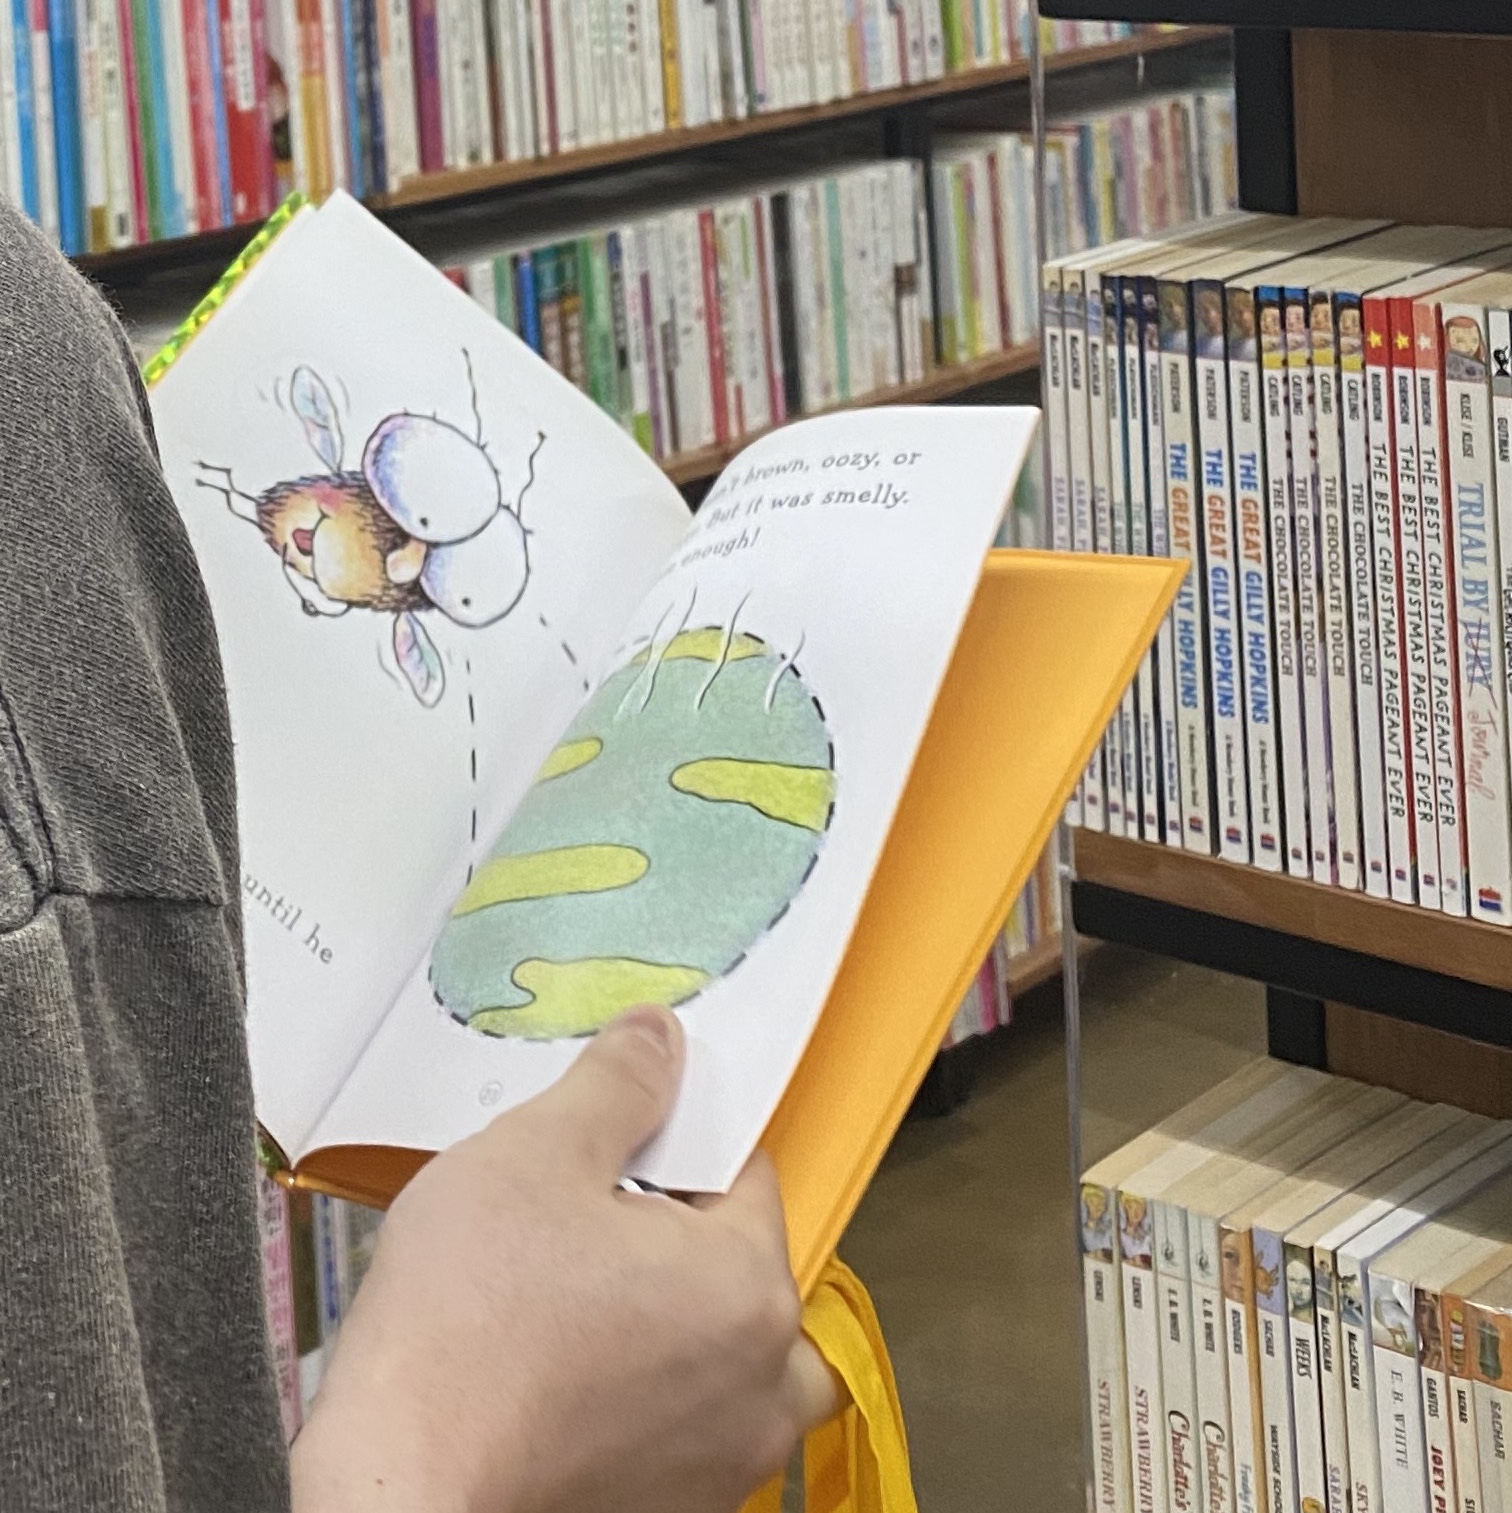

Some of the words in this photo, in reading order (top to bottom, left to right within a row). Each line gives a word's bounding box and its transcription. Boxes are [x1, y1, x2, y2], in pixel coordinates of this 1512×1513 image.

[820, 452, 880, 471] oozy,
[892, 451, 922, 466] or
[1170, 442, 1188, 482] THE
[1373, 443, 1389, 483] THE
[1399, 445, 1416, 485] THE
[1422, 447, 1439, 487] THE
[1497, 417, 1510, 462] GUTMAN
[1206, 449, 1223, 487] THE
[1239, 452, 1259, 491] THE
[1272, 477, 1284, 509] THE
[1296, 476, 1308, 509] THE
[1325, 475, 1338, 509] THE
[770, 491, 812, 510] was
[820, 483, 910, 509] smelly.
[1171, 486, 1191, 552] GREAT
[1352, 483, 1365, 515] THE
[1375, 491, 1392, 538] BEST
[1402, 493, 1419, 542] BEST
[1424, 495, 1441, 544] BEST
[1207, 494, 1228, 560] GREAT
[1241, 498, 1262, 564] GREAT
[1458, 482, 1488, 568] TRIAL
[1274, 515, 1290, 613] CHOCOLATE
[1298, 514, 1314, 613] CHOCOLATE
[1326, 514, 1342, 613] CHOCOLATE
[1353, 521, 1369, 621] CHOCOLATE
[1210, 567, 1231, 620] GILLY
[1245, 571, 1265, 626] GILLY
[1378, 547, 1397, 660] CHRISTMAS
[1405, 550, 1425, 664] CHRISTMAS
[1427, 552, 1448, 667] CHRISTMAS
[1462, 576, 1490, 613] BY
[1178, 618, 1198, 709] HOPKINS
[1214, 627, 1236, 718] HOPKINS
[1280, 620, 1293, 676] TOUCH
[1303, 620, 1317, 677] TOUCH
[1331, 619, 1345, 677] TOUCH
[1359, 629, 1373, 686] TOUCH
[1248, 631, 1270, 724] HOPKINS
[1384, 667, 1402, 760] PAGEANT
[1410, 672, 1430, 765] PAGEANT
[1432, 675, 1453, 768] PAGEANT
[1388, 767, 1405, 818] EVER
[1416, 772, 1434, 823] EVER
[1438, 775, 1456, 827] EVER
[244, 874, 303, 931] until
[303, 923, 333, 964] he
[1295, 1337, 1312, 1380] WEEKS
[1427, 1377, 1440, 1419] GANTOS
[1097, 1378, 1115, 1511] STRAWBERRY
[1393, 1413, 1409, 1469] WHITE
[1490, 1400, 1506, 1461] SACHAR
[1168, 1410, 1192, 1511] Charlotte's
[1203, 1420, 1229, 1513] Charlotte
[1431, 1445, 1446, 1491] JOEY
